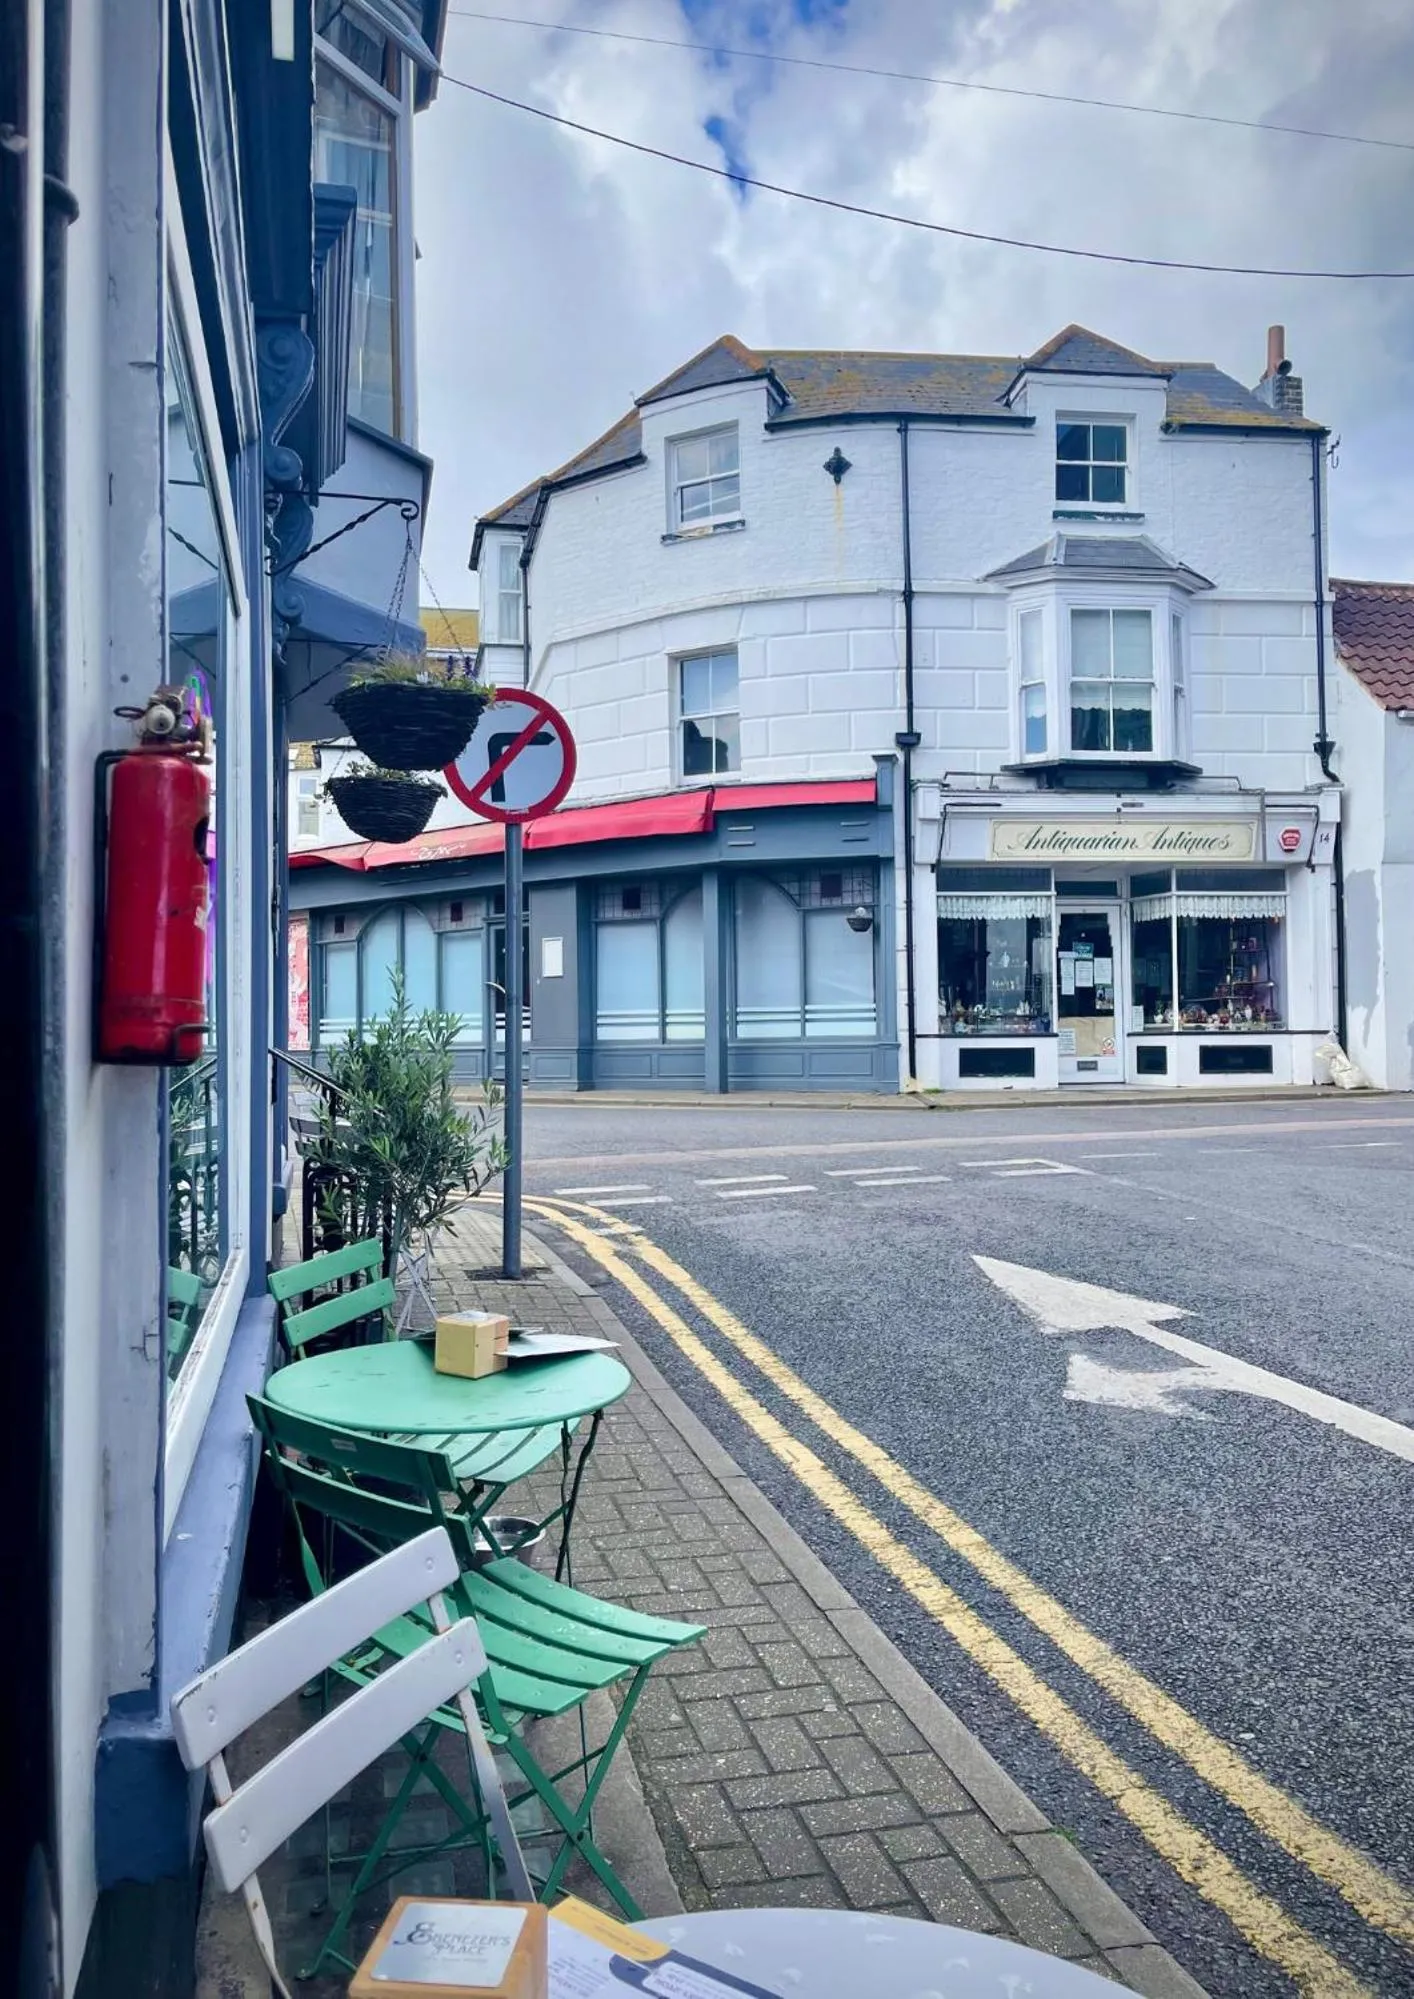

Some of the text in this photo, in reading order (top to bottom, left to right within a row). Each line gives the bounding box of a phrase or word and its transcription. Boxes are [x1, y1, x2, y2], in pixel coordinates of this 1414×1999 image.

[1007, 825, 1231, 855] Antiquarian Antiques
[1320, 832, 1331, 844] 14
